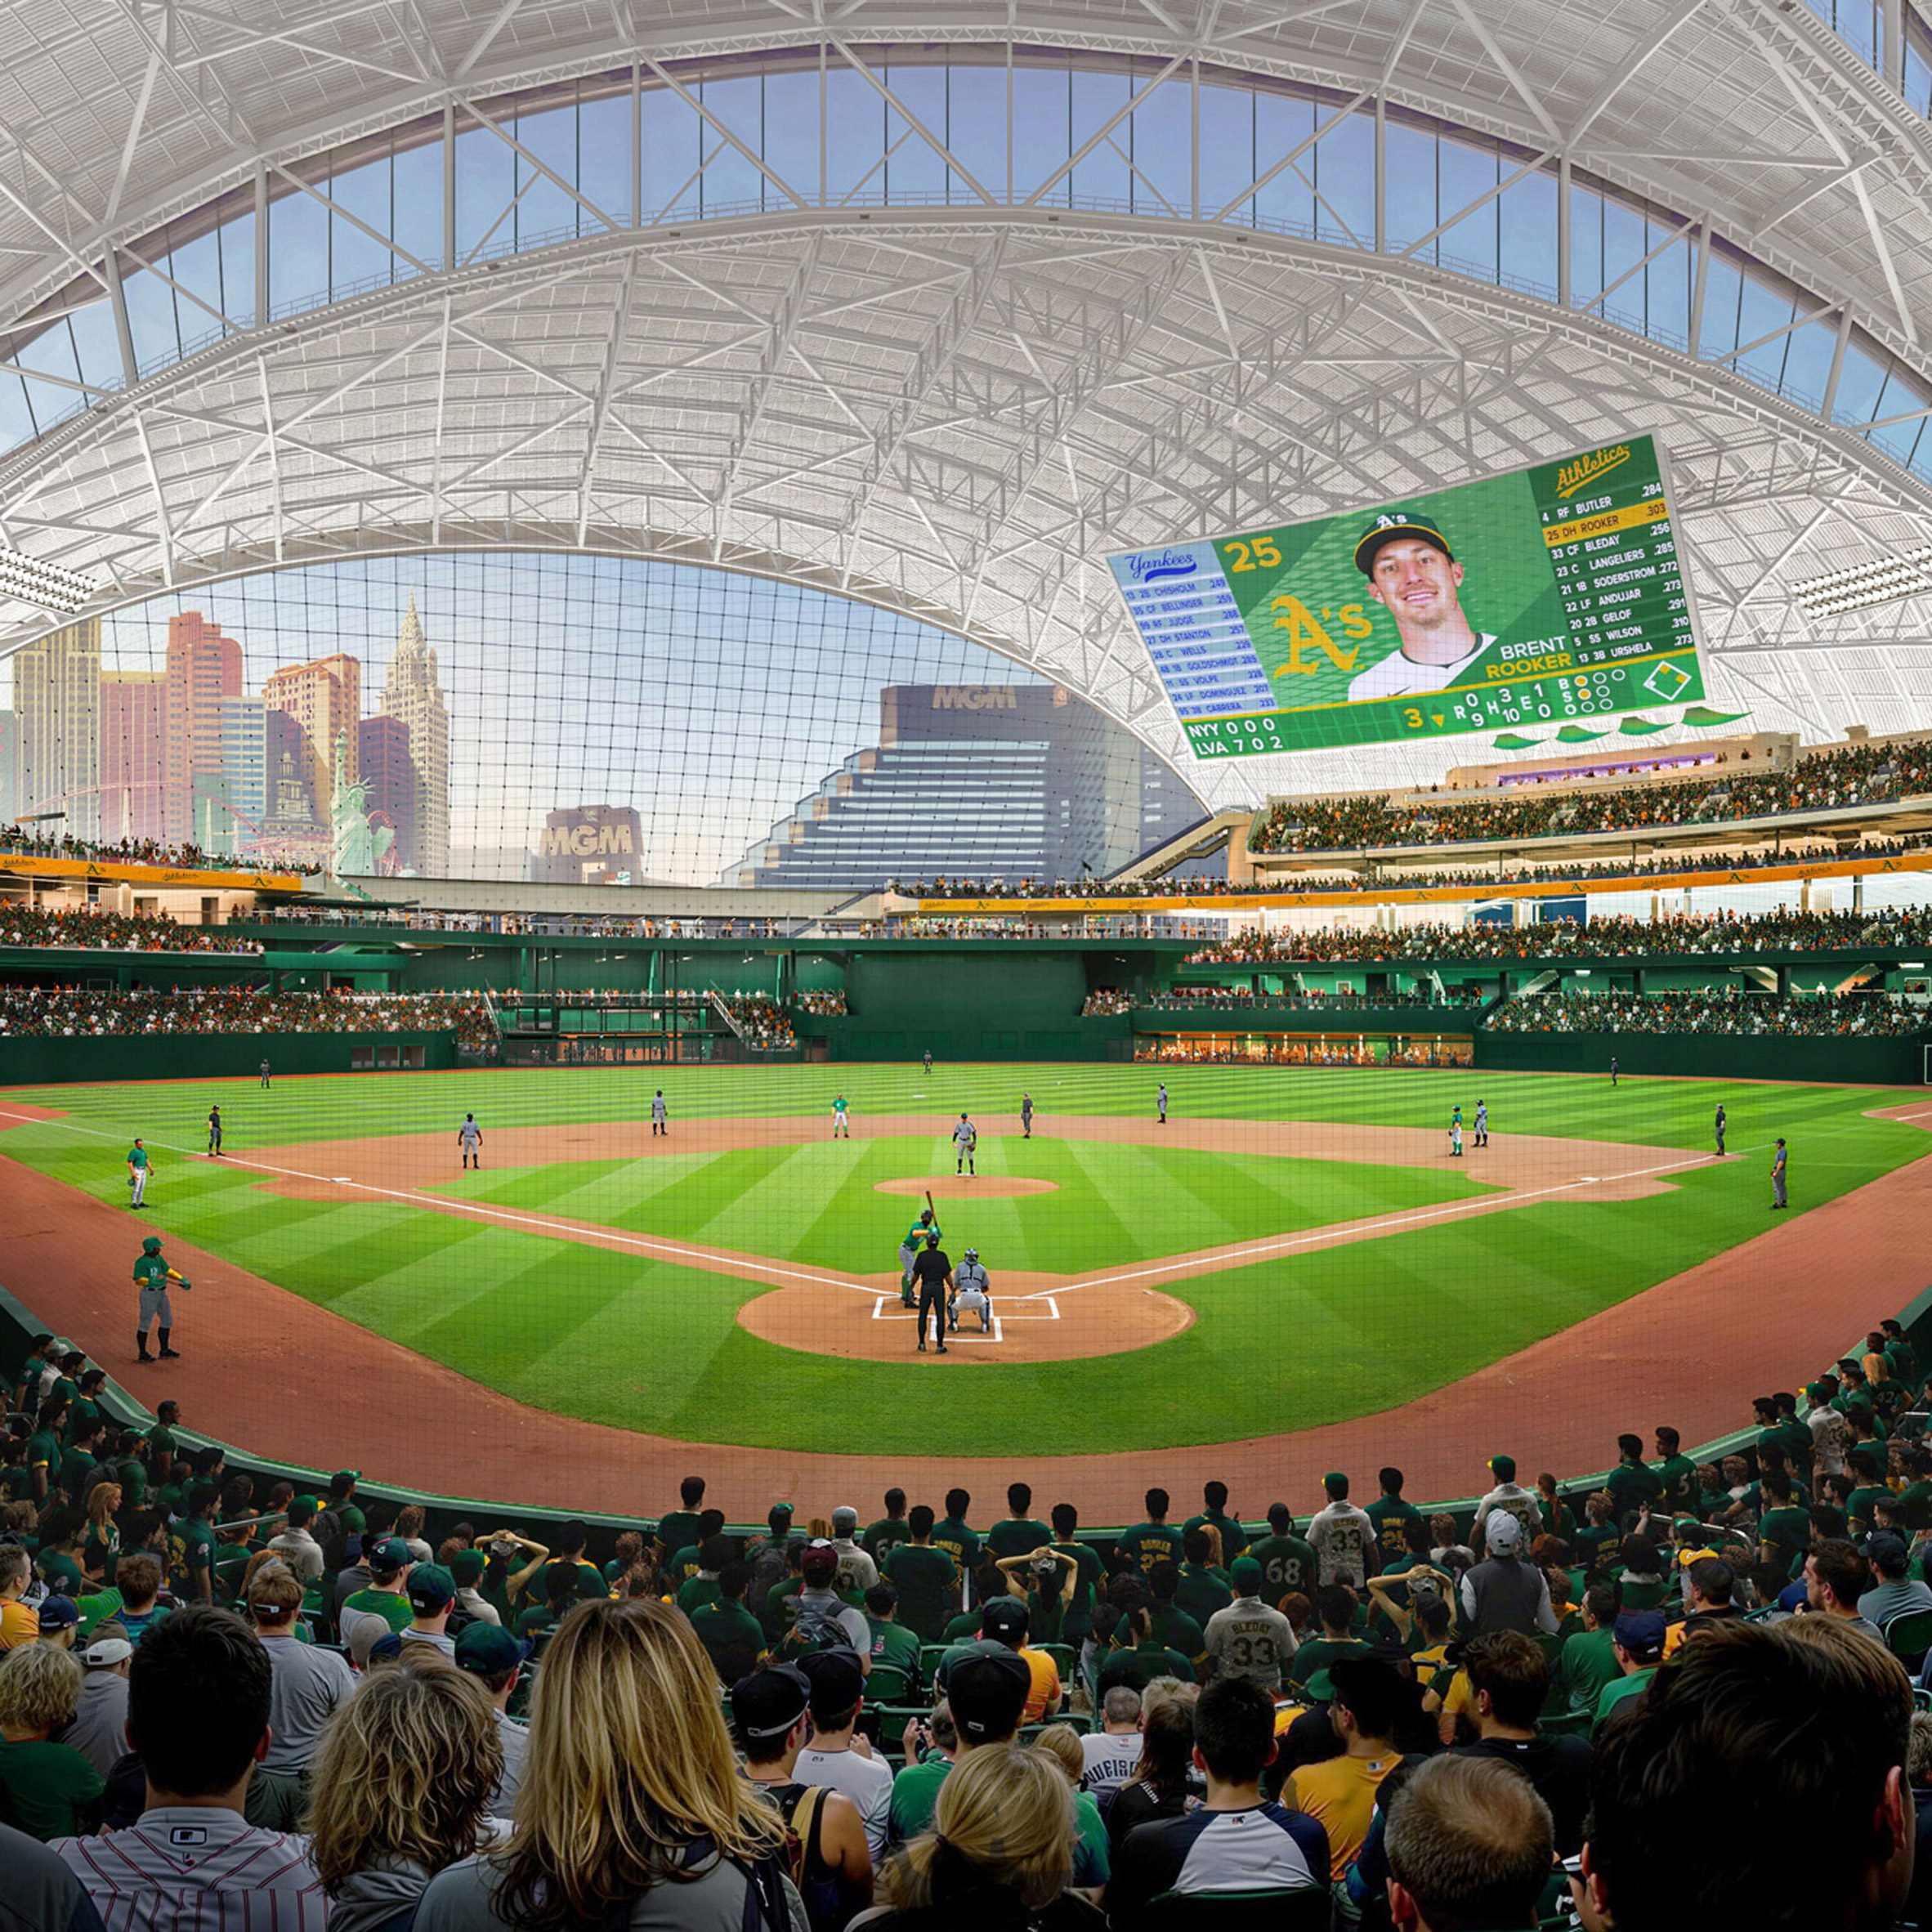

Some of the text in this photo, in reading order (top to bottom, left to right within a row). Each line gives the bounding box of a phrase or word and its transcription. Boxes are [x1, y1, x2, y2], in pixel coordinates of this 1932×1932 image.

[1556, 445, 1630, 497] Athletics
[1542, 482, 1662, 522] 4 RF BUTLER .284
[1375, 514, 1407, 529] A's
[1547, 530, 1559, 542] 25
[1562, 526, 1576, 538] DH
[1581, 515, 1619, 533] ROOKER
[1223, 536, 1282, 573] 25
[1551, 548, 1564, 560] 33
[1567, 544, 1579, 556] CF
[1585, 534, 1621, 552] BLEDAY
[1556, 542, 1675, 578] 23 C LANGELIERS .285
[1125, 550, 1195, 580] Yankees
[1561, 585, 1572, 595] 21
[1594, 566, 1657, 588] SODERSTROM
[1658, 561, 1679, 574] .272
[1565, 579, 1682, 613] 22 LF ANDUJAR .273
[1569, 619, 1582, 630] 20
[1603, 609, 1632, 624] GELOF
[1174, 629, 1211, 642] STANTON
[1271, 595, 1373, 679] A's
[1500, 636, 1566, 660] BRENT
[1574, 637, 1581, 646] 5
[1589, 633, 1601, 644] SS
[1606, 626, 1643, 640] WILSON
[1610, 642, 1653, 657] URSHELA
[1674, 634, 1693, 646] .273
[1166, 650, 1173, 658] C
[1180, 646, 1207, 655] WELLS
[1486, 652, 1572, 679] ROOKER
[1193, 675, 1220, 685] VOLPE
[1465, 678, 1569, 707] 0 3 1 B
[932, 686, 1017, 709] MGM
[1453, 691, 1572, 719] R H E S
[1188, 718, 1275, 738] NYY 0 0 0
[1404, 708, 1424, 728] 3
[1472, 713, 1485, 727] 9
[1502, 708, 1521, 722] 10
[1538, 704, 1551, 718] 0
[1196, 736, 1283, 755] LVA 7 0 2
[538, 825, 633, 858] MGM
[1330, 1528, 1362, 1552] 33
[1267, 1557, 1302, 1585] 68
[1232, 1621, 1272, 1635] BLEDAY
[1232, 1636, 1275, 1666] 33
